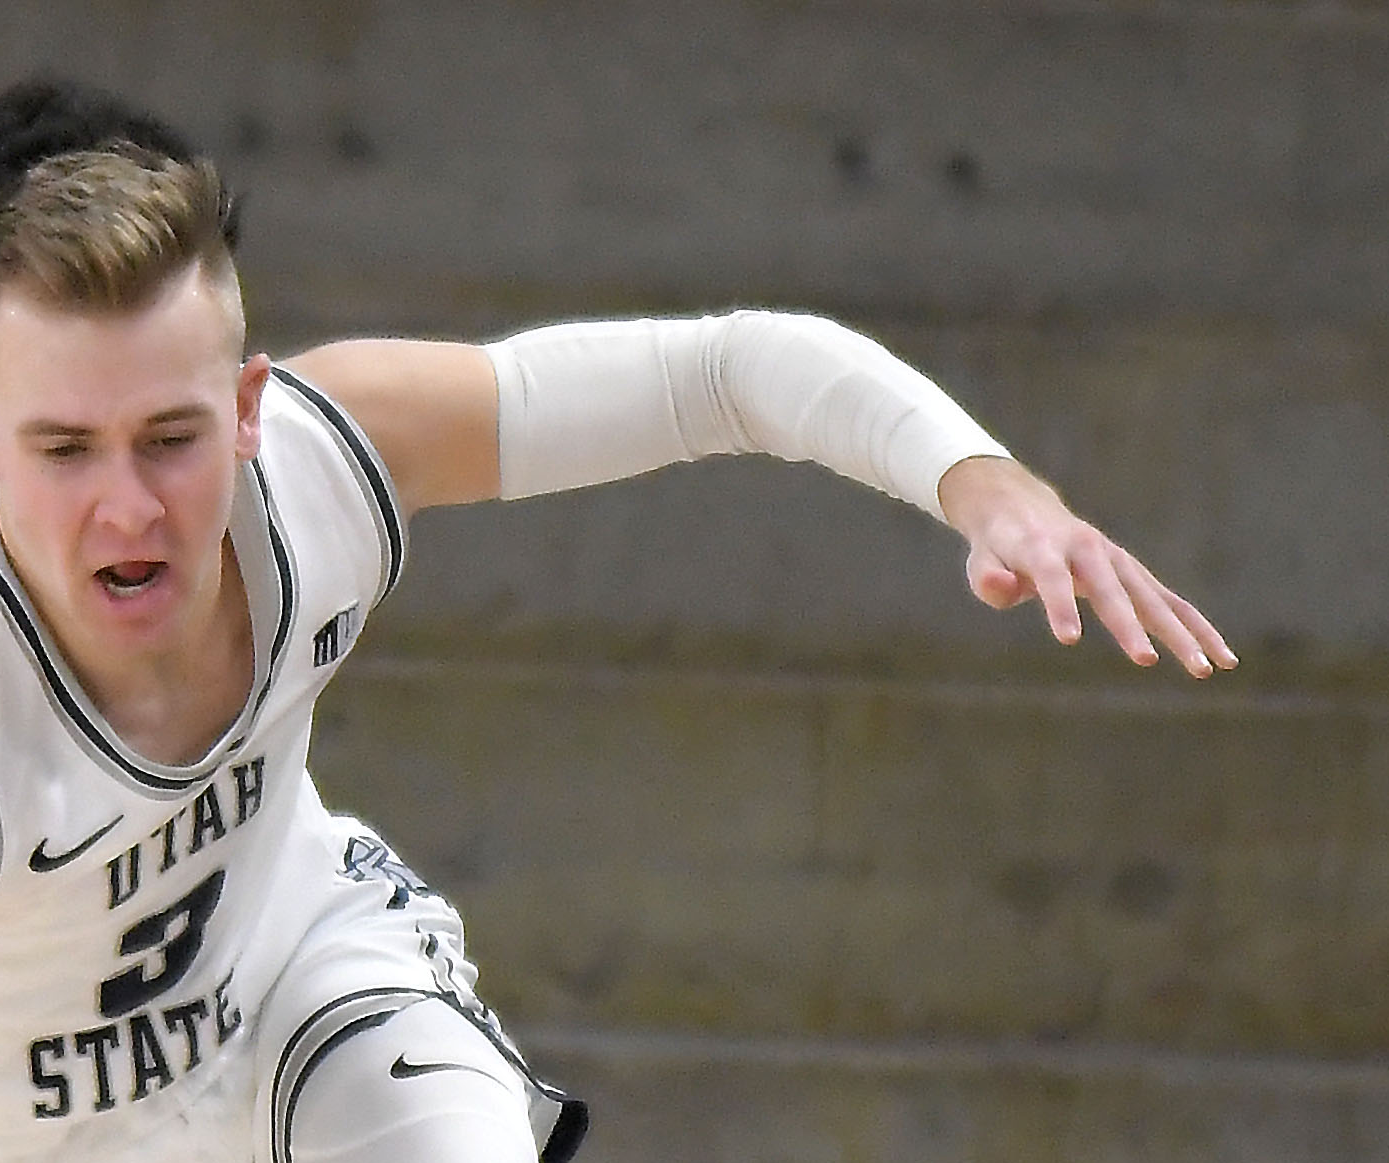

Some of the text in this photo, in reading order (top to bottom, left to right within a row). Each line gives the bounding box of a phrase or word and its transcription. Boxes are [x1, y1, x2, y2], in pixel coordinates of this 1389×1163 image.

[107, 756, 265, 909] UTAH
[99, 869, 226, 1018] 3
[29, 967, 242, 1119] STATE
